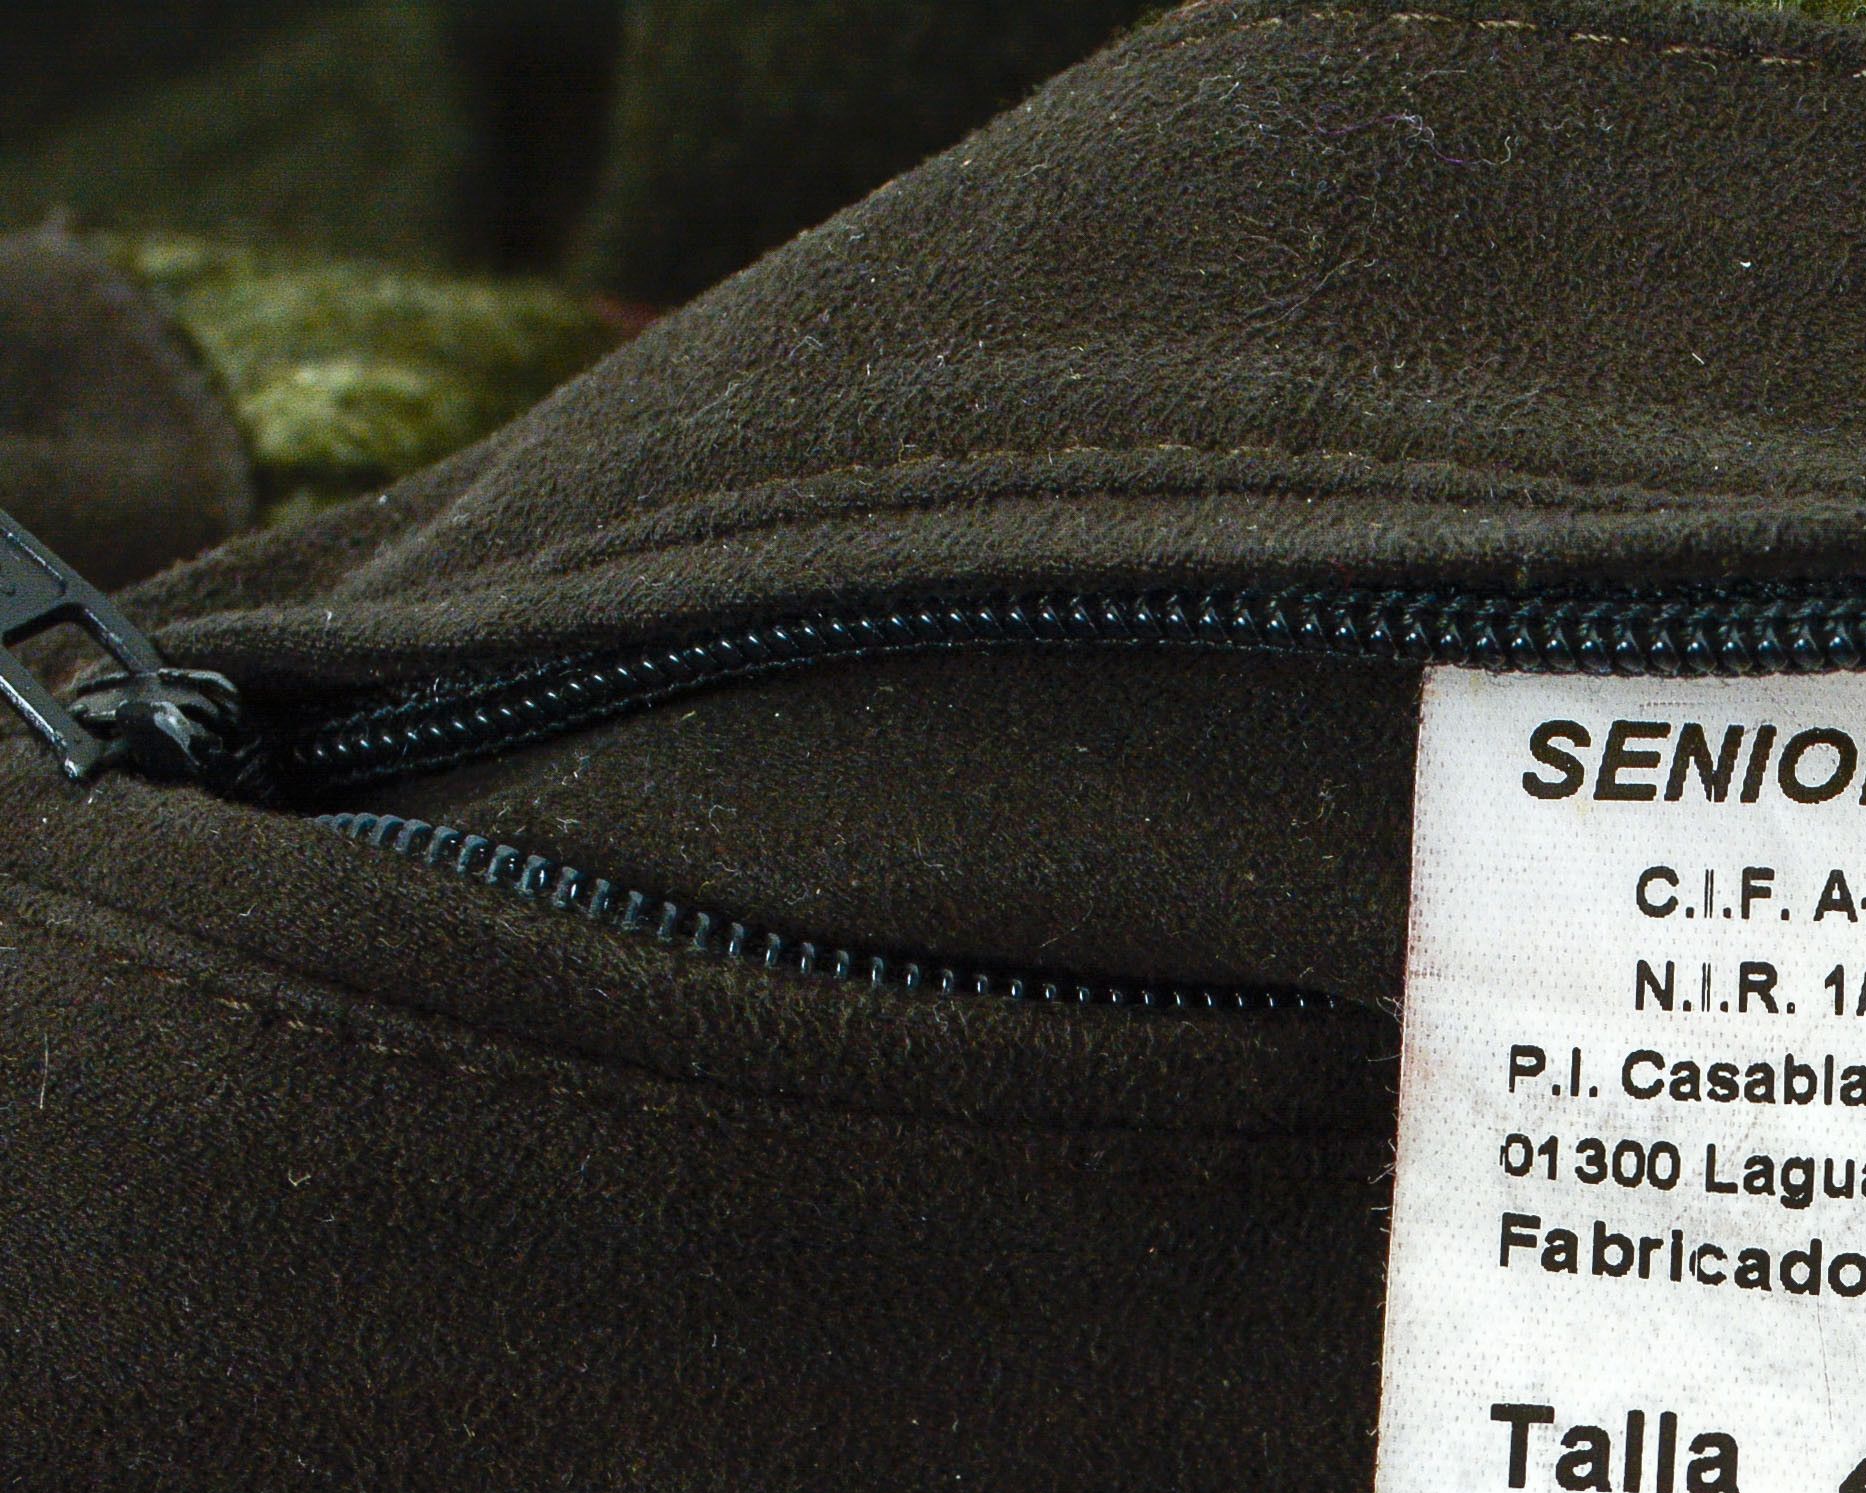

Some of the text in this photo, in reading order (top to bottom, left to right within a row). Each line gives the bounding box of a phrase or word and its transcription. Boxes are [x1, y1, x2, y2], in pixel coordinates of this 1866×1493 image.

[1637, 866, 1789, 920] C.I.F.
[1636, 960, 1795, 1013] N.I.R.
[1509, 1045, 1599, 1100] P.I.
[1500, 1134, 1680, 1190] 01300
